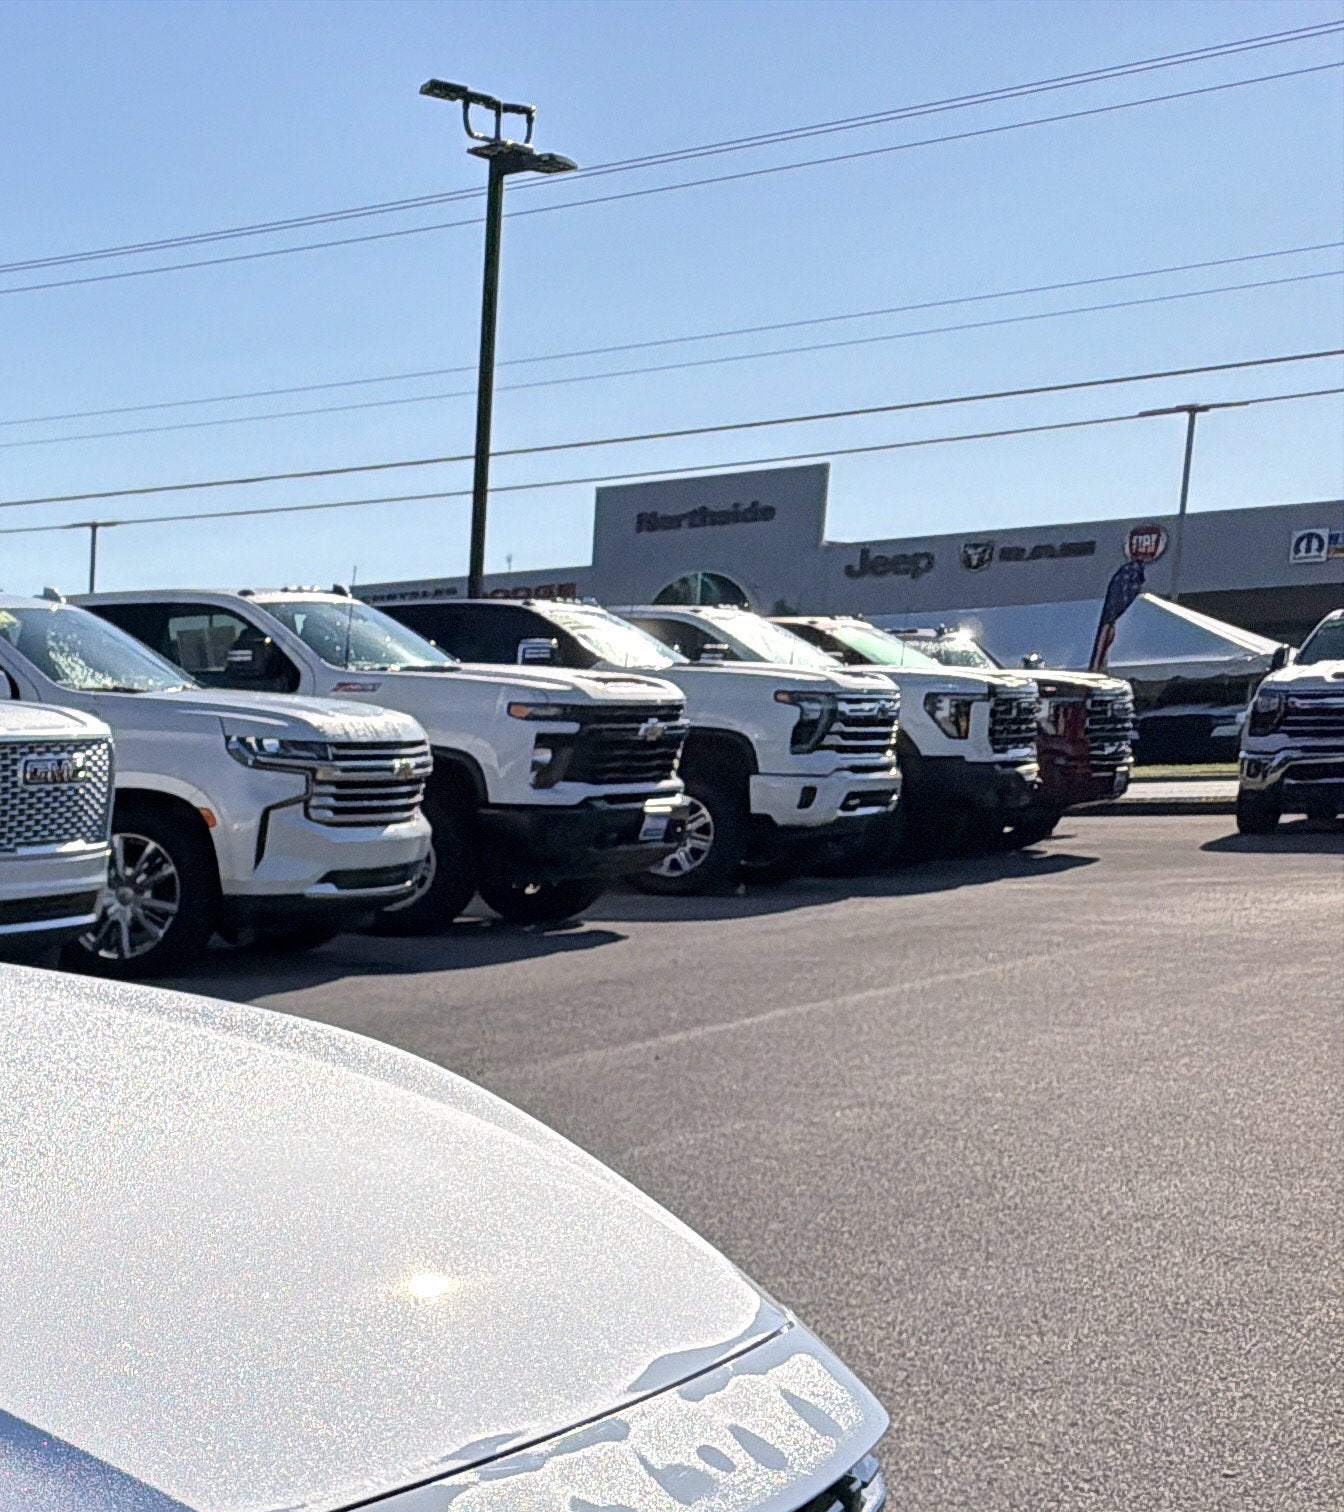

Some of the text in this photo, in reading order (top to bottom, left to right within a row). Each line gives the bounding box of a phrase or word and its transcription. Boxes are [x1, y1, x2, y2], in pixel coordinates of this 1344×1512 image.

[636, 501, 776, 533] Northside
[844, 548, 935, 579] Jeep
[482, 583, 577, 599] ODGE
